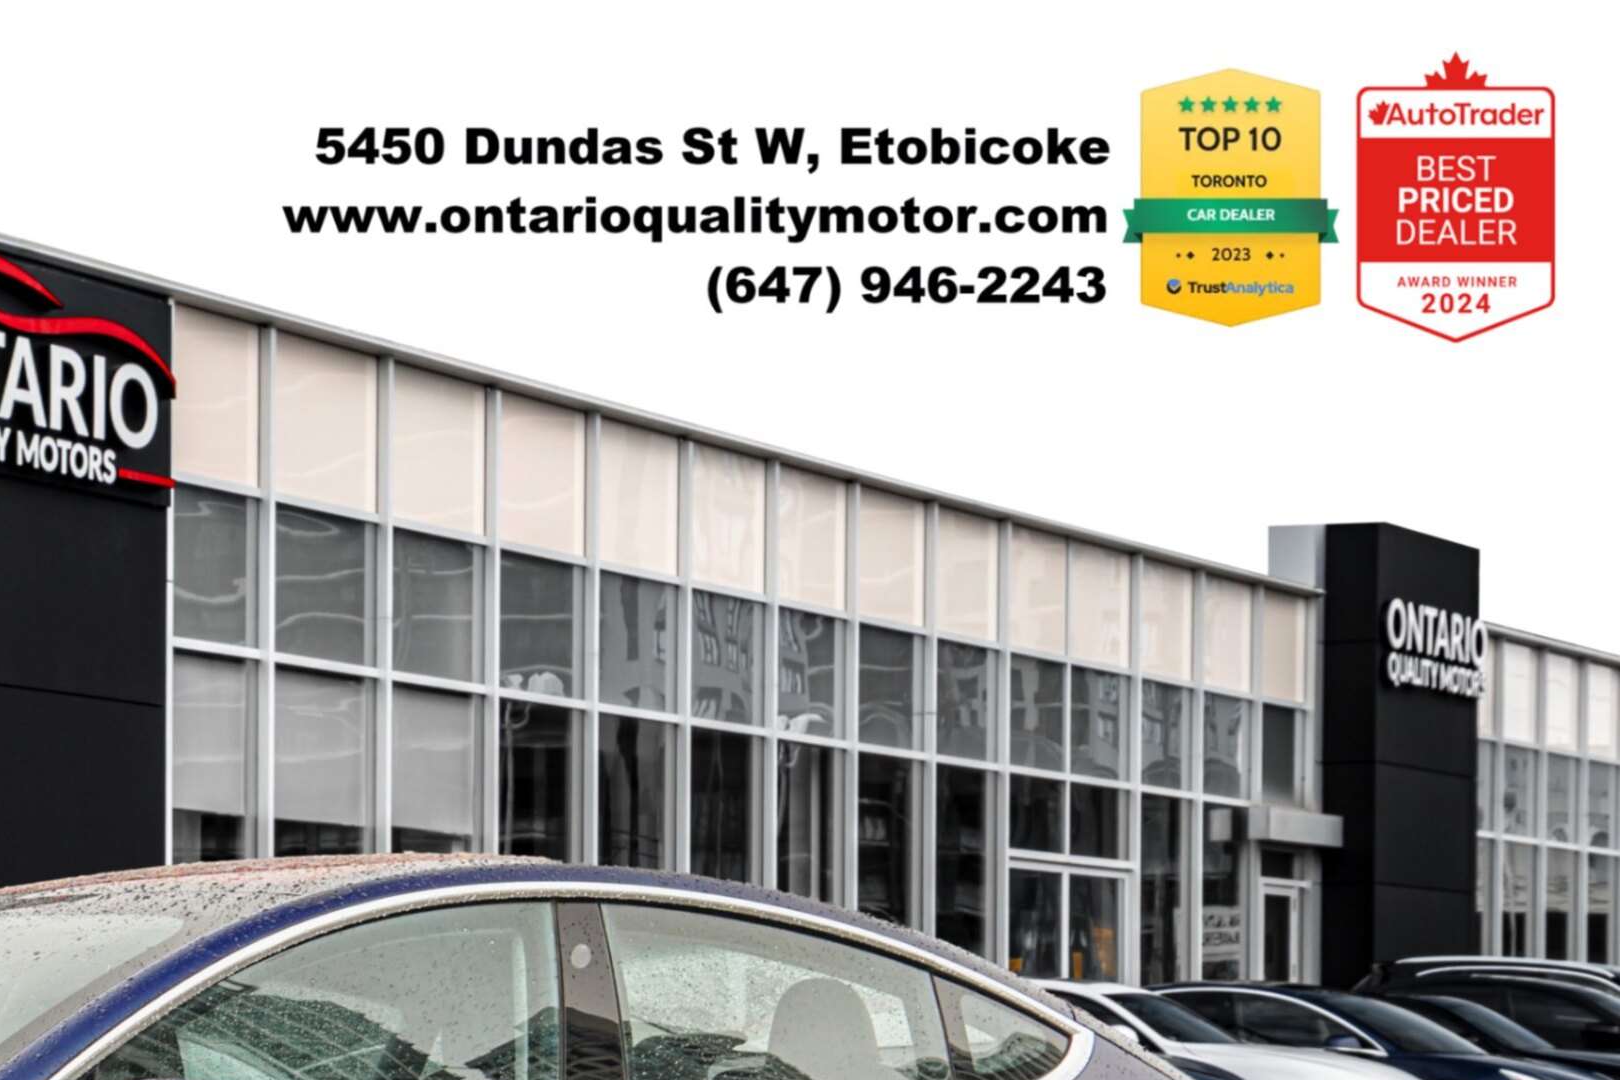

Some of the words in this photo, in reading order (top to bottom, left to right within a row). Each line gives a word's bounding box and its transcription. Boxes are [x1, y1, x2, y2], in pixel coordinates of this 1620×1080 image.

[15, 429, 118, 484] MOTORS
[1386, 597, 1489, 667] ONTARIO
[1387, 652, 1439, 688] QUALITY
